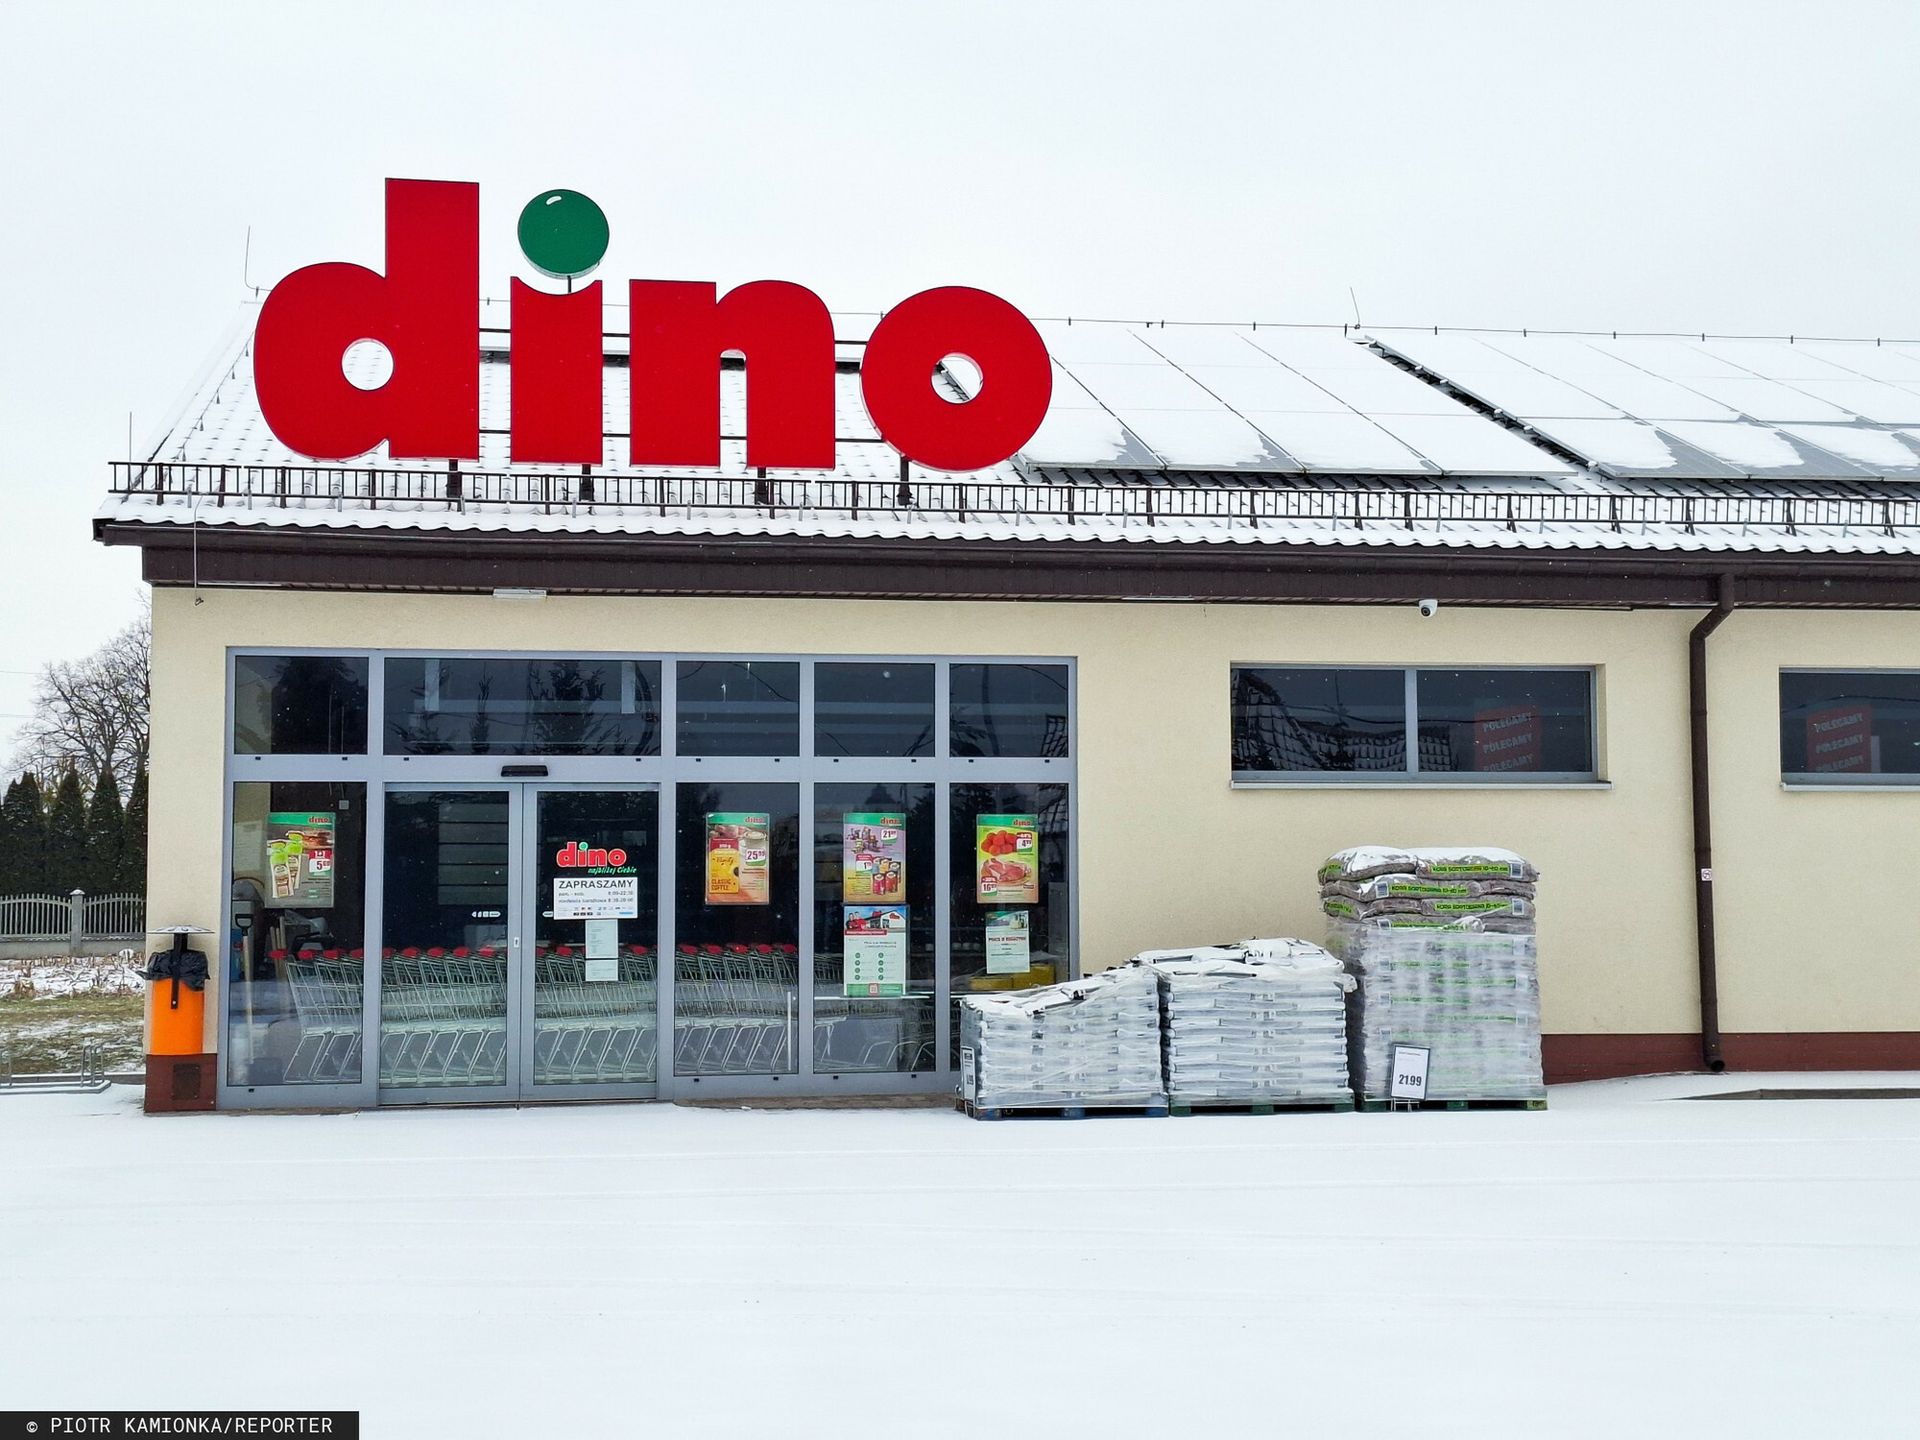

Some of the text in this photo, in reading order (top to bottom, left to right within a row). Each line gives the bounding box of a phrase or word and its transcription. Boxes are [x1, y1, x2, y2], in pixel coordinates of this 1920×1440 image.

[253, 178, 1053, 471] dino
[1483, 712, 1532, 732] POLECAMY
[1483, 733, 1532, 753] POLECAMY
[556, 841, 627, 868] dino
[558, 880, 634, 889] ZAPRASZAMY
